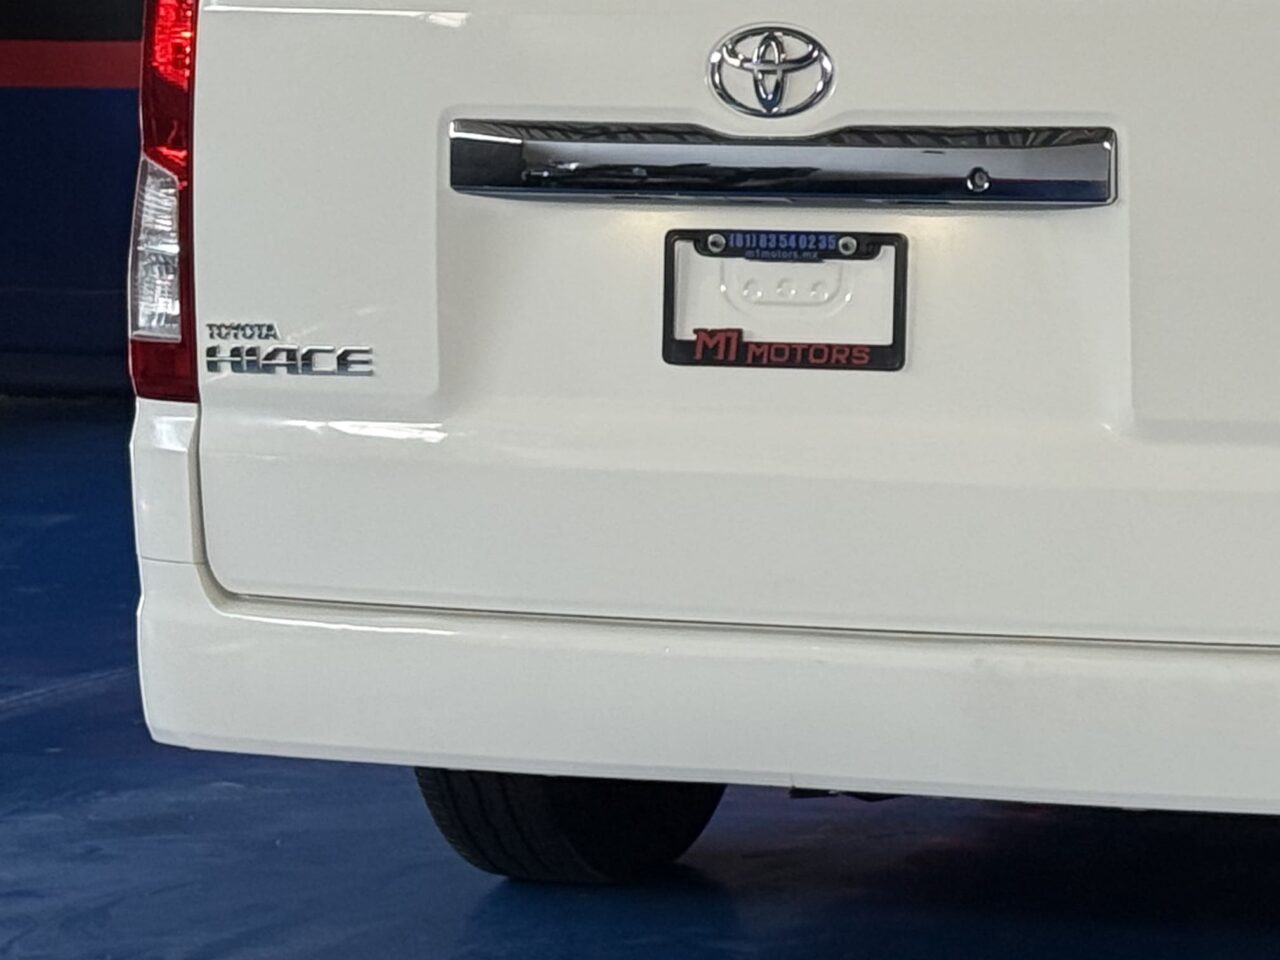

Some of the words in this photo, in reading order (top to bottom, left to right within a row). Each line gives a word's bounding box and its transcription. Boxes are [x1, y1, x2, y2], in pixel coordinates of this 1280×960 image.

[206, 323, 280, 340] TOYOTA
[693, 328, 742, 361] M1
[748, 343, 870, 365] MOTORS
[206, 344, 374, 376] HIACE
